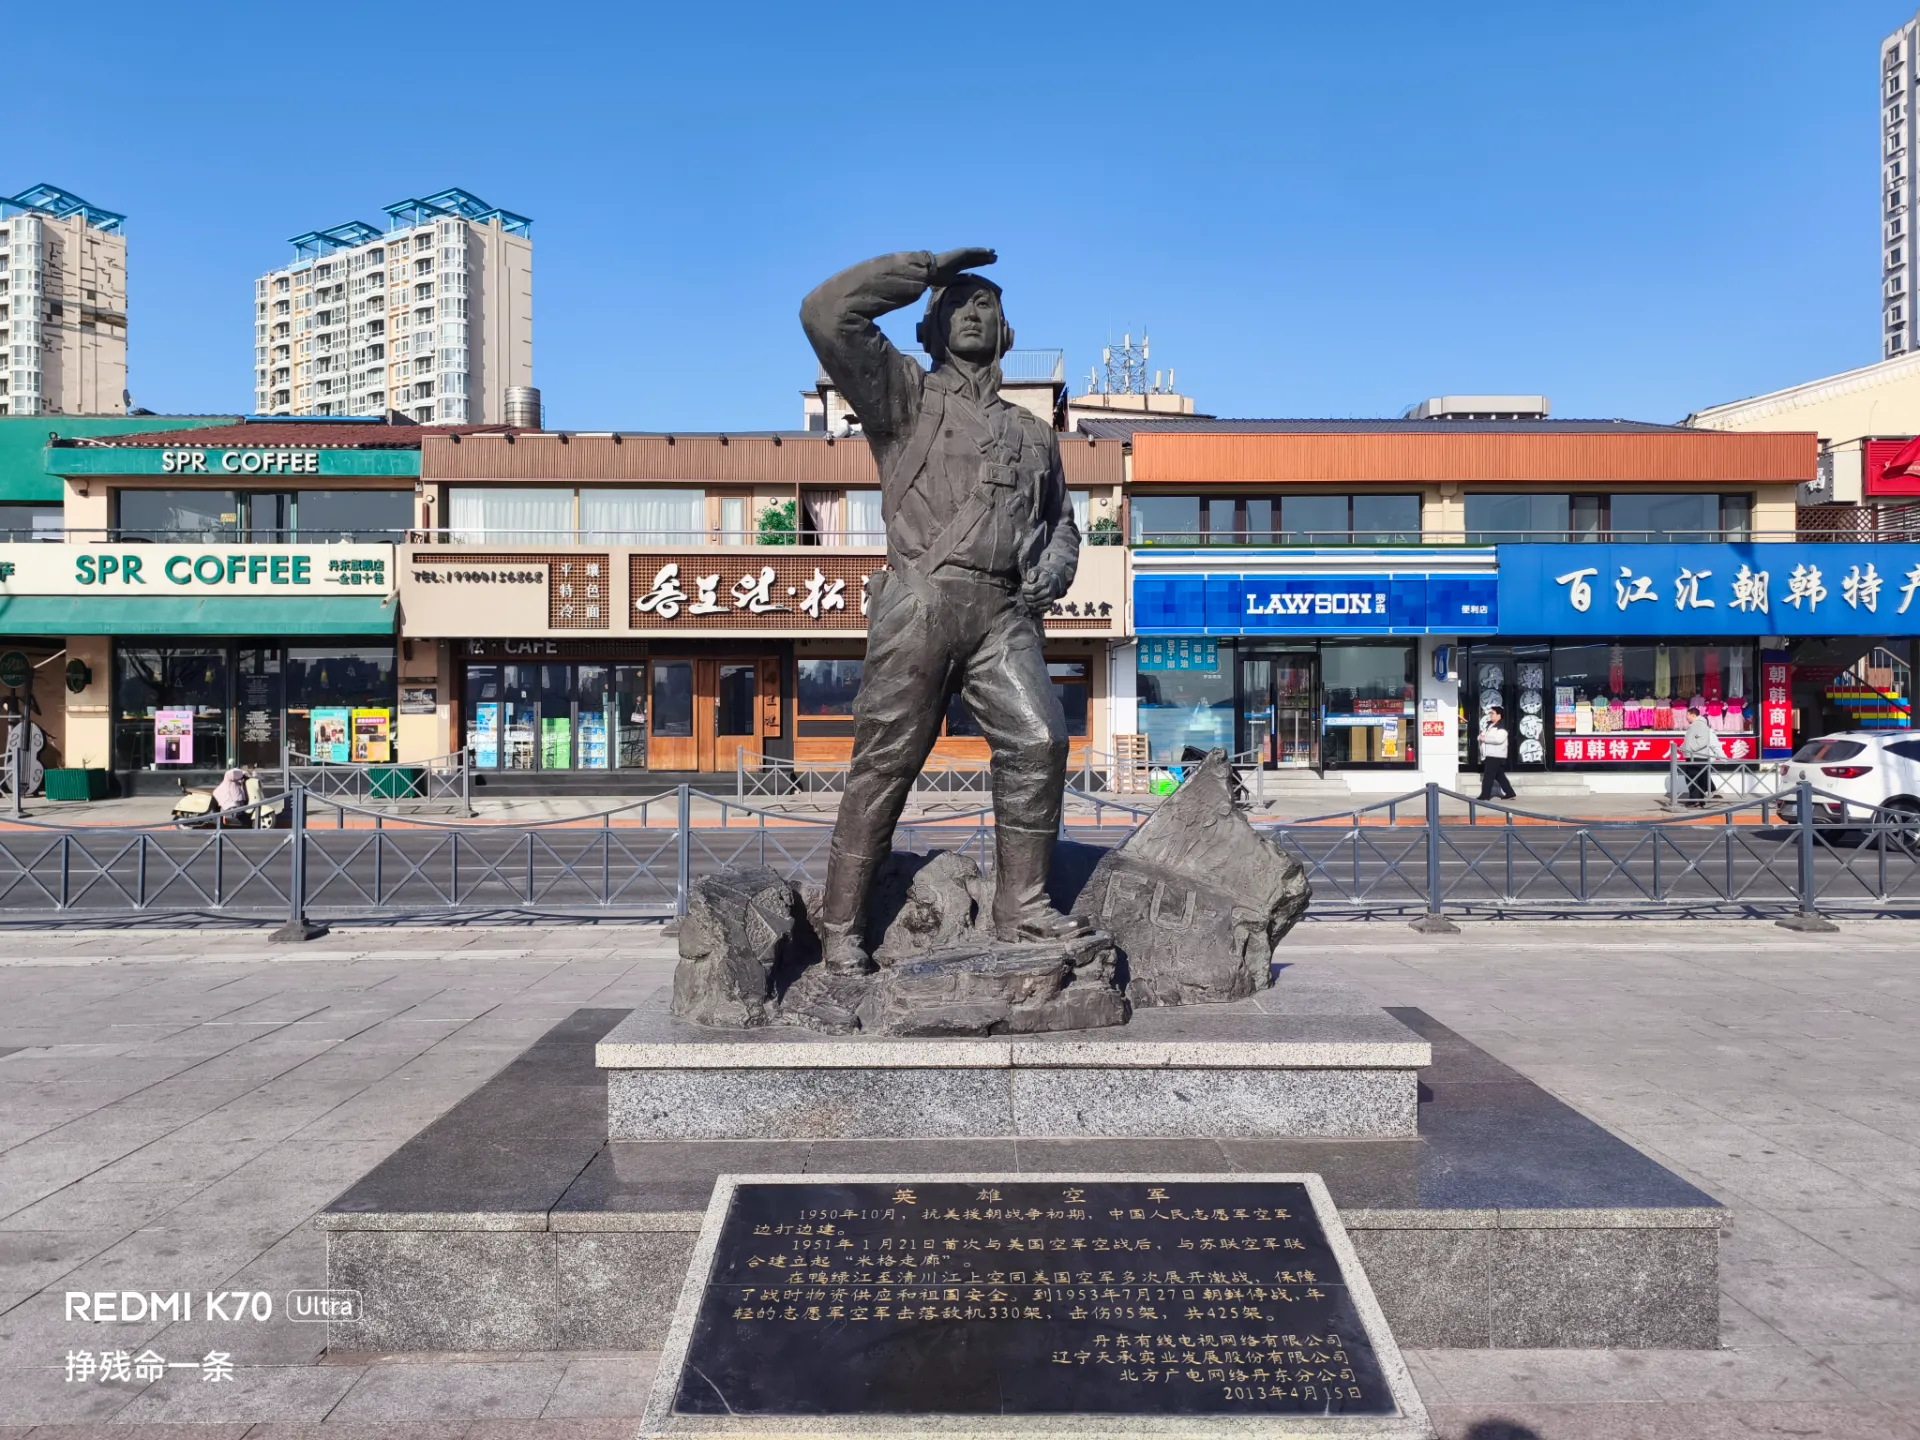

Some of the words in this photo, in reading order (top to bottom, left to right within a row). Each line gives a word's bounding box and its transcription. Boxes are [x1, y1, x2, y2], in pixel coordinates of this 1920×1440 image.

[162, 451, 209, 472] SPR
[222, 451, 319, 472] COFFEE
[75, 555, 147, 585] SPR
[165, 555, 311, 585] COFFEE
[1246, 594, 1372, 614] LAWSON
[1375, 593, 1386, 614] 罗森
[1461, 604, 1488, 614] 便利店
[1769, 666, 1786, 747] 朝韩商品
[1563, 740, 1652, 760] 朝韩特产
[753, 1224, 845, 1236] 边打边建。
[1093, 1334, 1342, 1348] 丹东有线电视网络有限公司
[1120, 1368, 1356, 1383] 北方广电网络丹东分公司
[1223, 1386, 1363, 1401] 2013年4月15日
